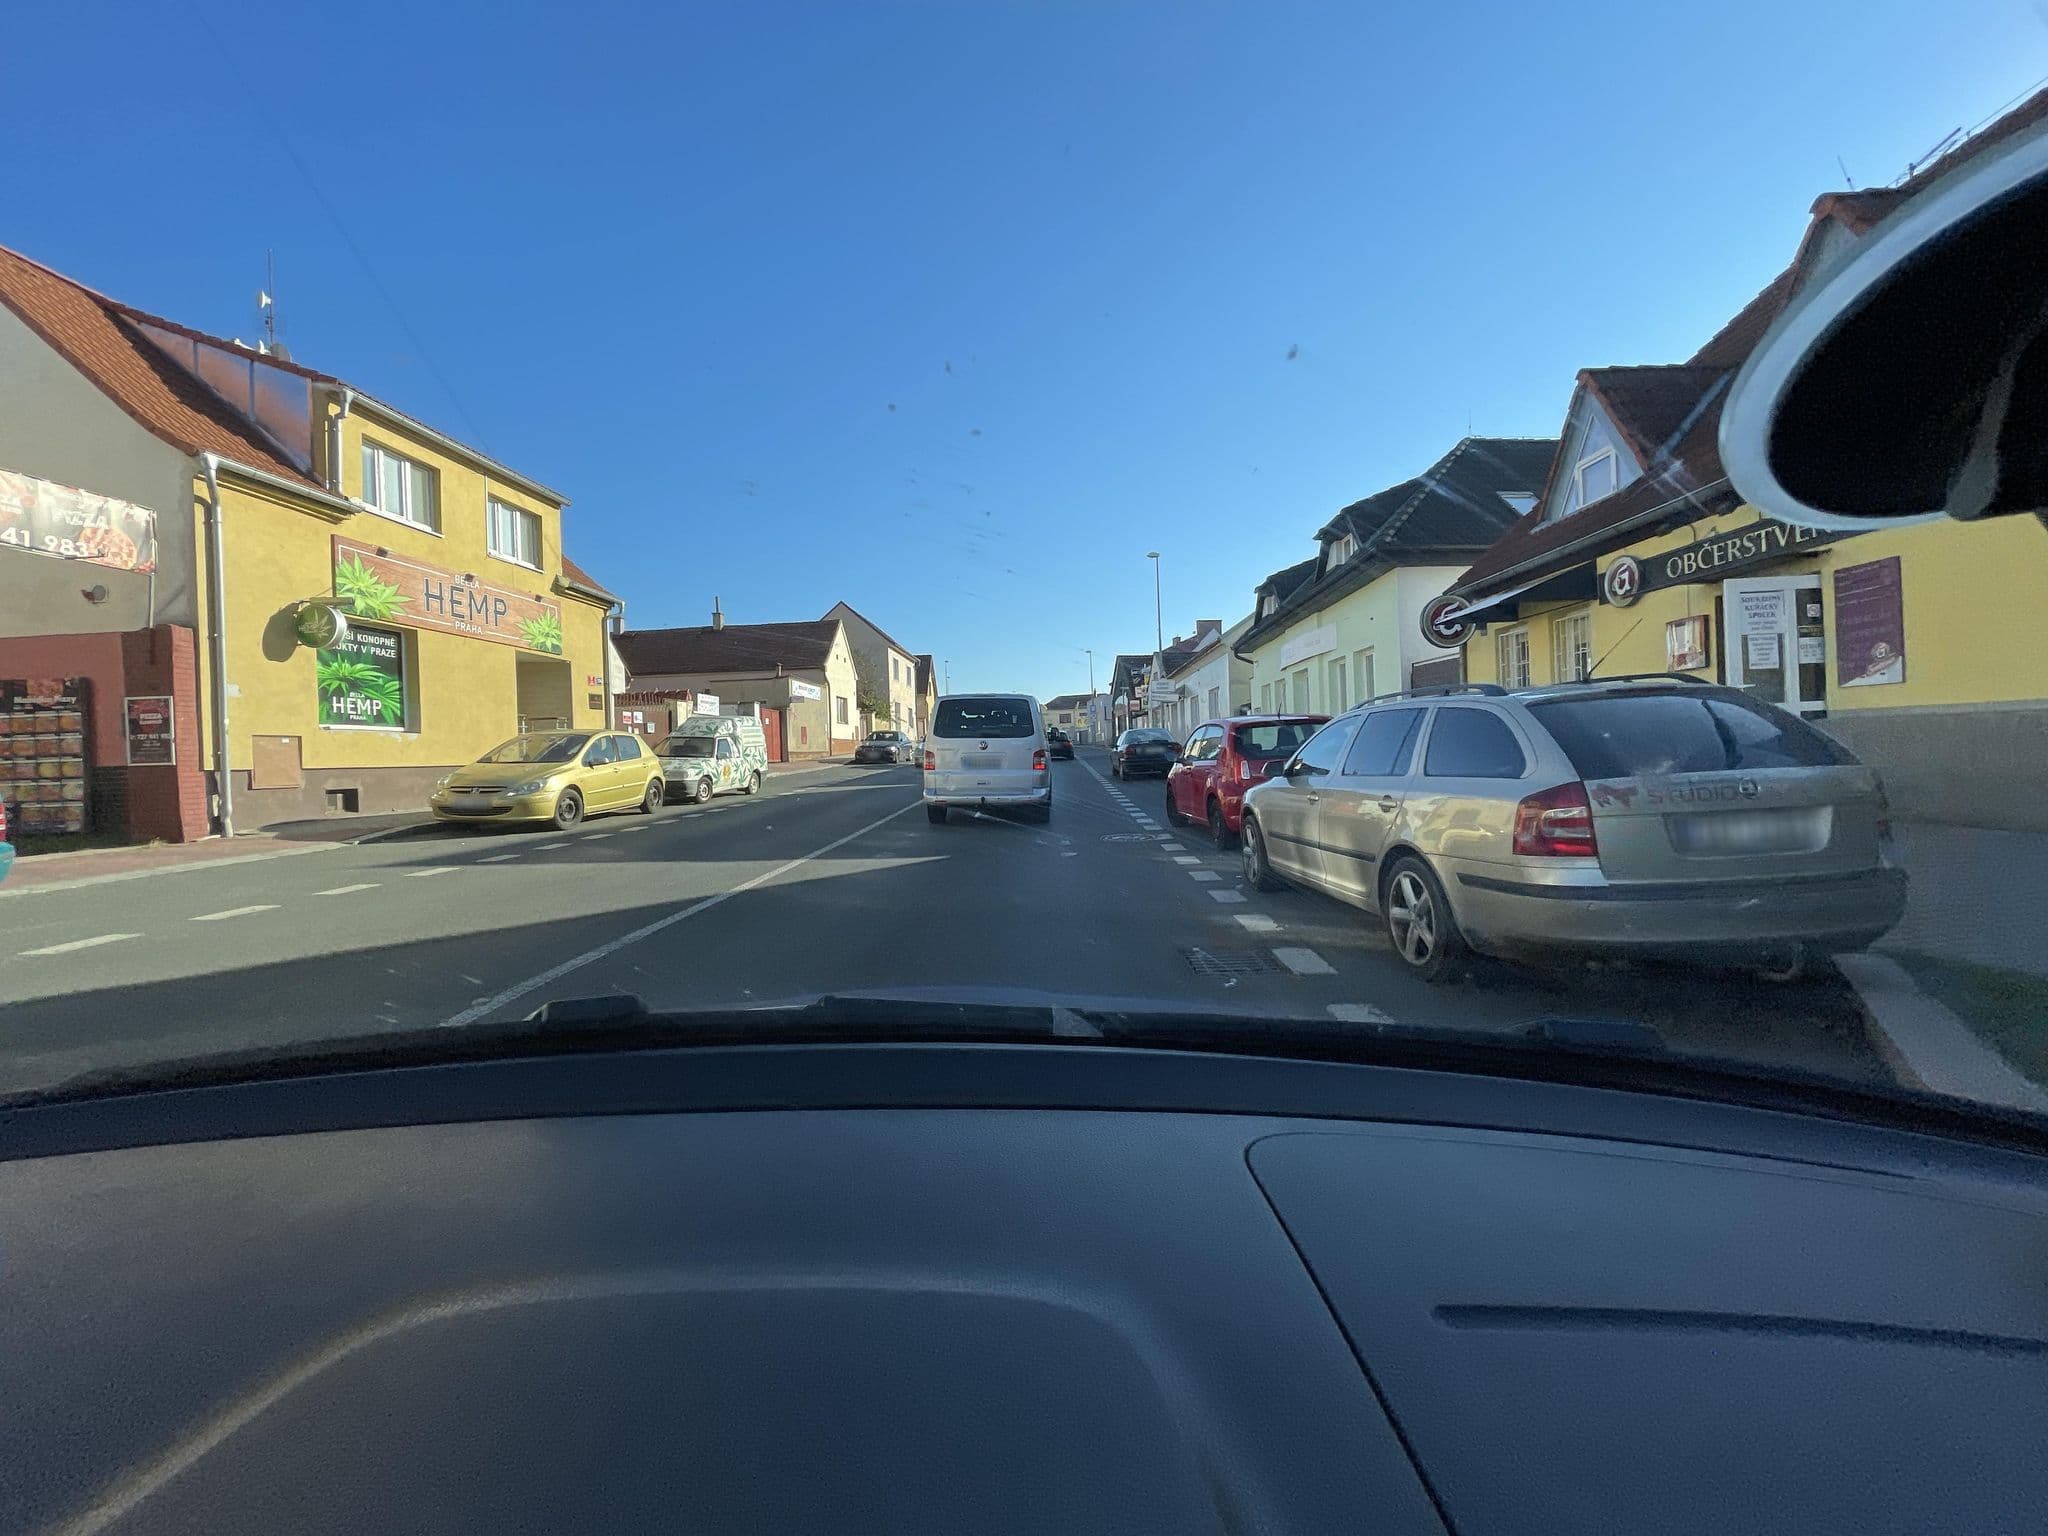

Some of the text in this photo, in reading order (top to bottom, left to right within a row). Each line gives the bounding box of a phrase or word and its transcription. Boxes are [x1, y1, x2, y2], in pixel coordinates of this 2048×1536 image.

[44, 534, 89, 558] 983
[1666, 522, 1831, 579] OBČERSTVE
[423, 577, 508, 628] HEMP
[455, 621, 482, 634] PRAHA
[357, 633, 396, 647] KONOPNÉ
[361, 645, 367, 655] V
[371, 647, 397, 658] PRAZE
[332, 696, 382, 716] HEMP
